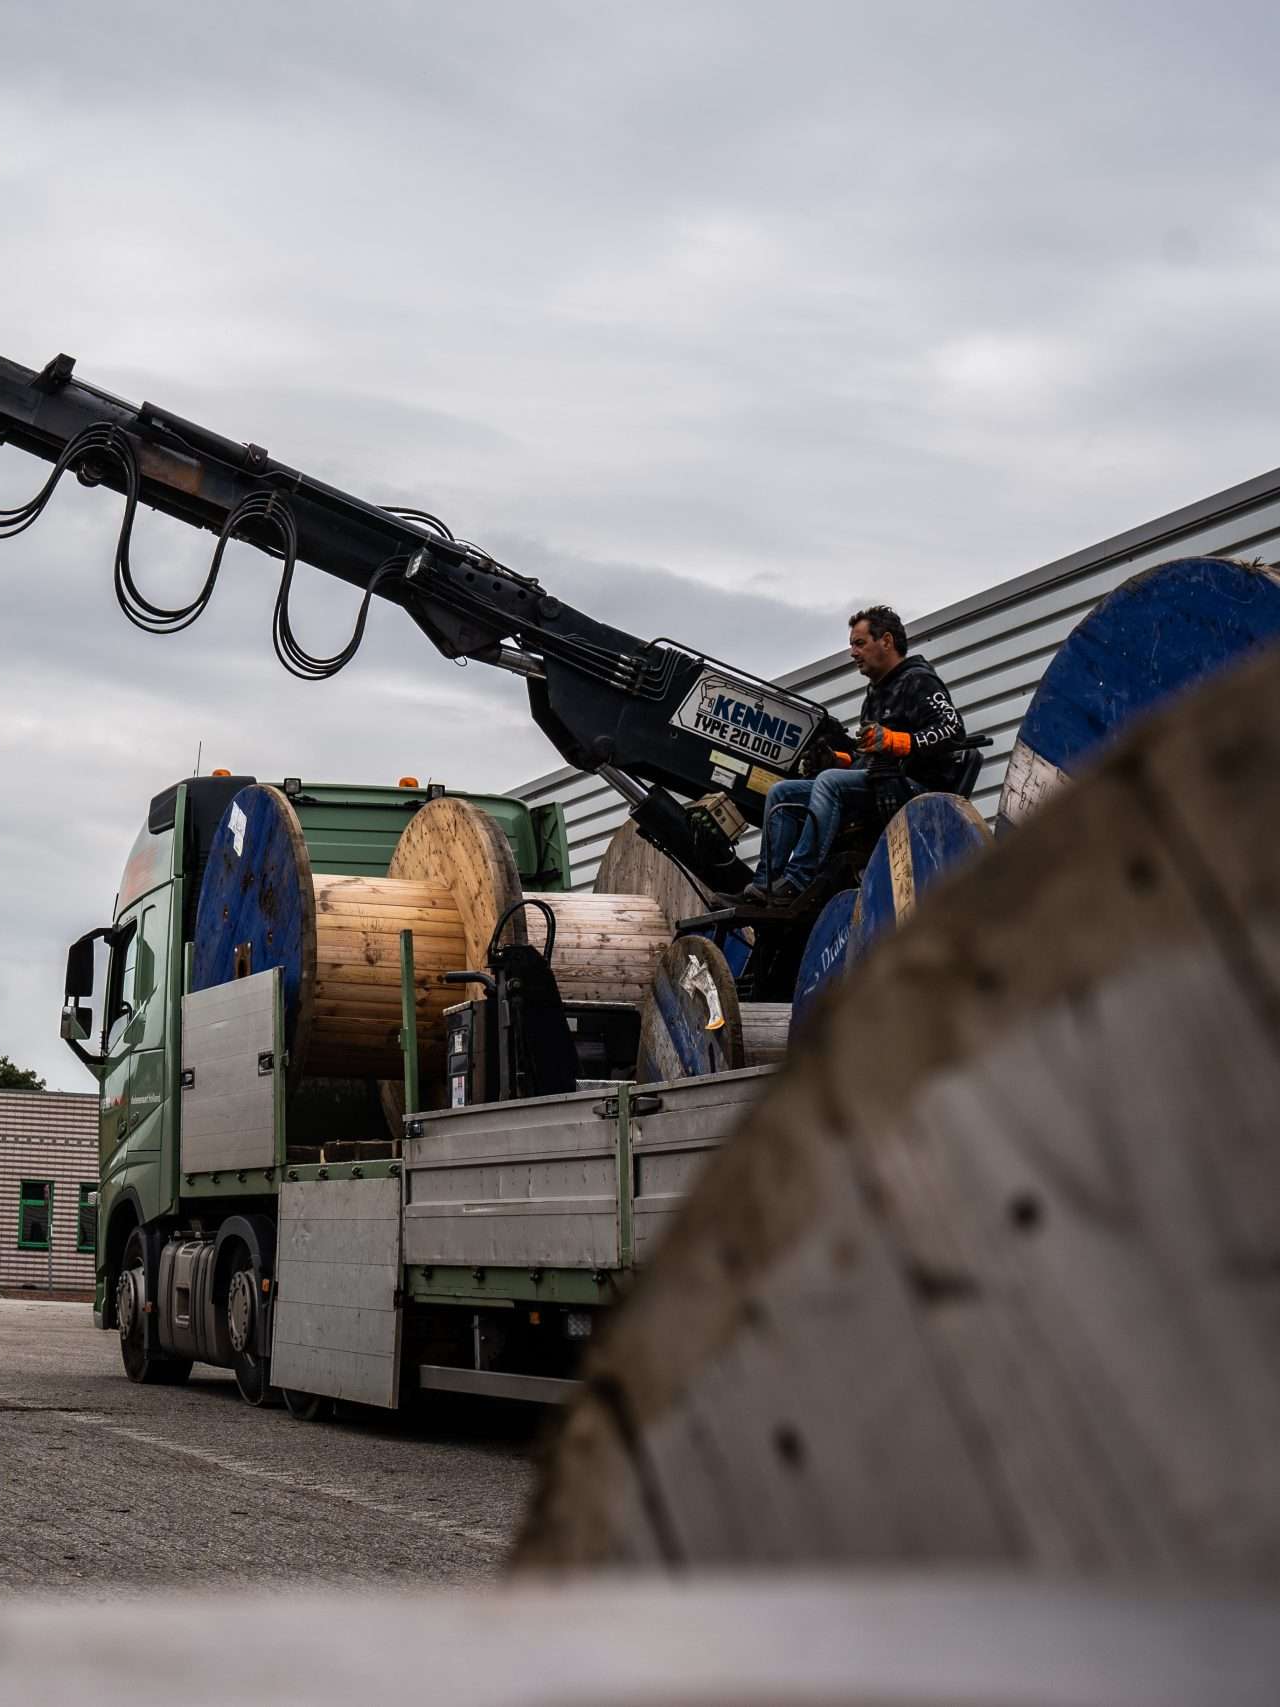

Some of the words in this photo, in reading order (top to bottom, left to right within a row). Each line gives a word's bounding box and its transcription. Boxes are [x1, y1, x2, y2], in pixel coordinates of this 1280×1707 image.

[694, 712, 729, 739] TYPE
[729, 728, 782, 760] 20.000
[713, 694, 802, 748] KENNIS
